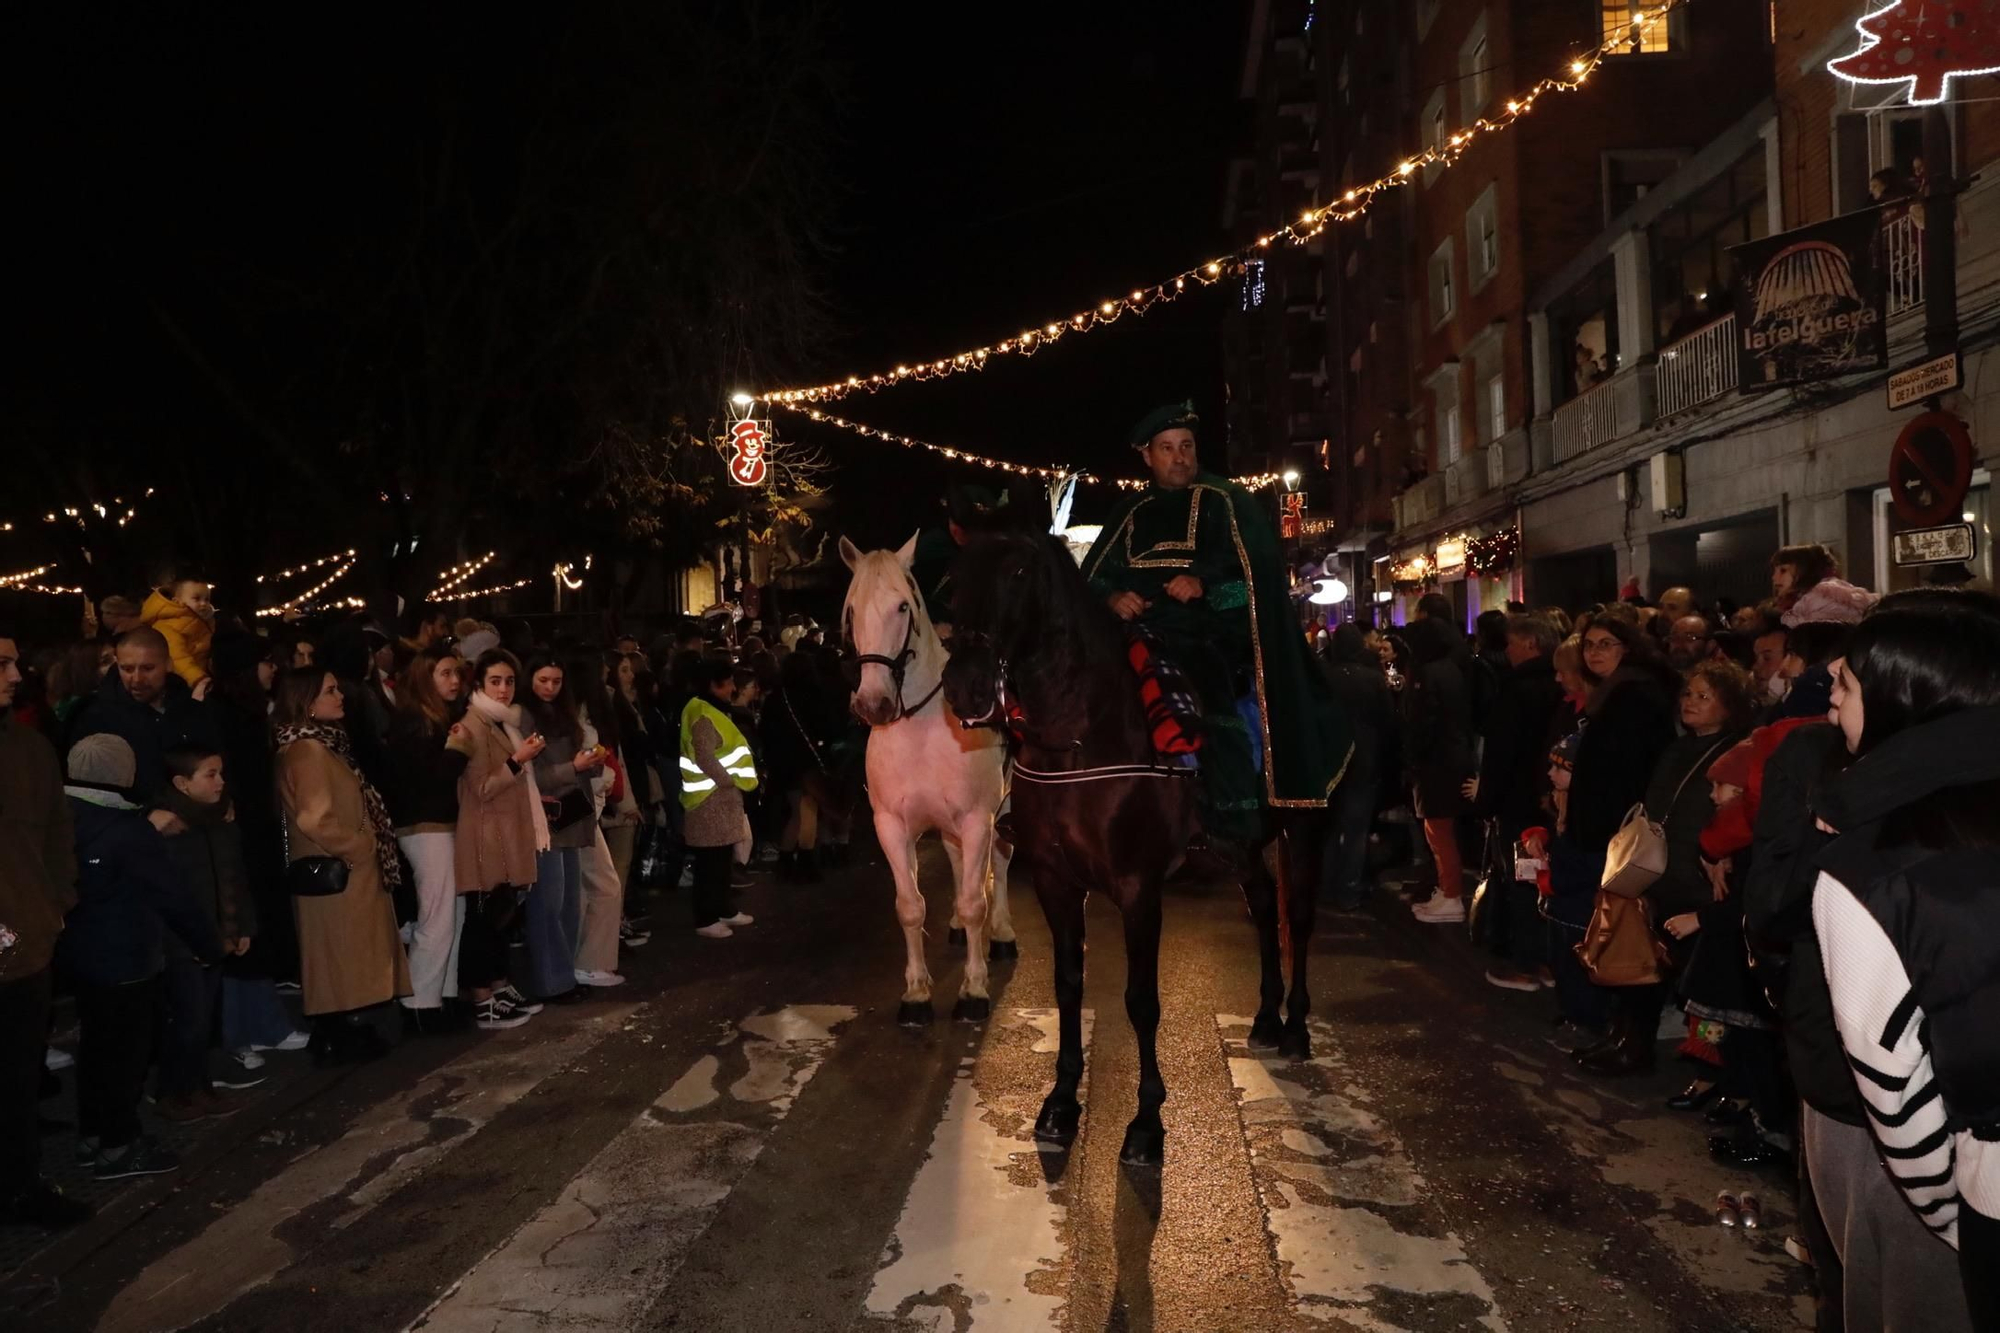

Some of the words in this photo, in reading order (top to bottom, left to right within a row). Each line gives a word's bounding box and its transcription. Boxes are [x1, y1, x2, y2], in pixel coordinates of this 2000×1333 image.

[1896, 389, 1905, 402] DE
[1905, 388, 1910, 399] 7
[1911, 386, 1916, 396] A
[1925, 374, 1949, 391] HORAS
